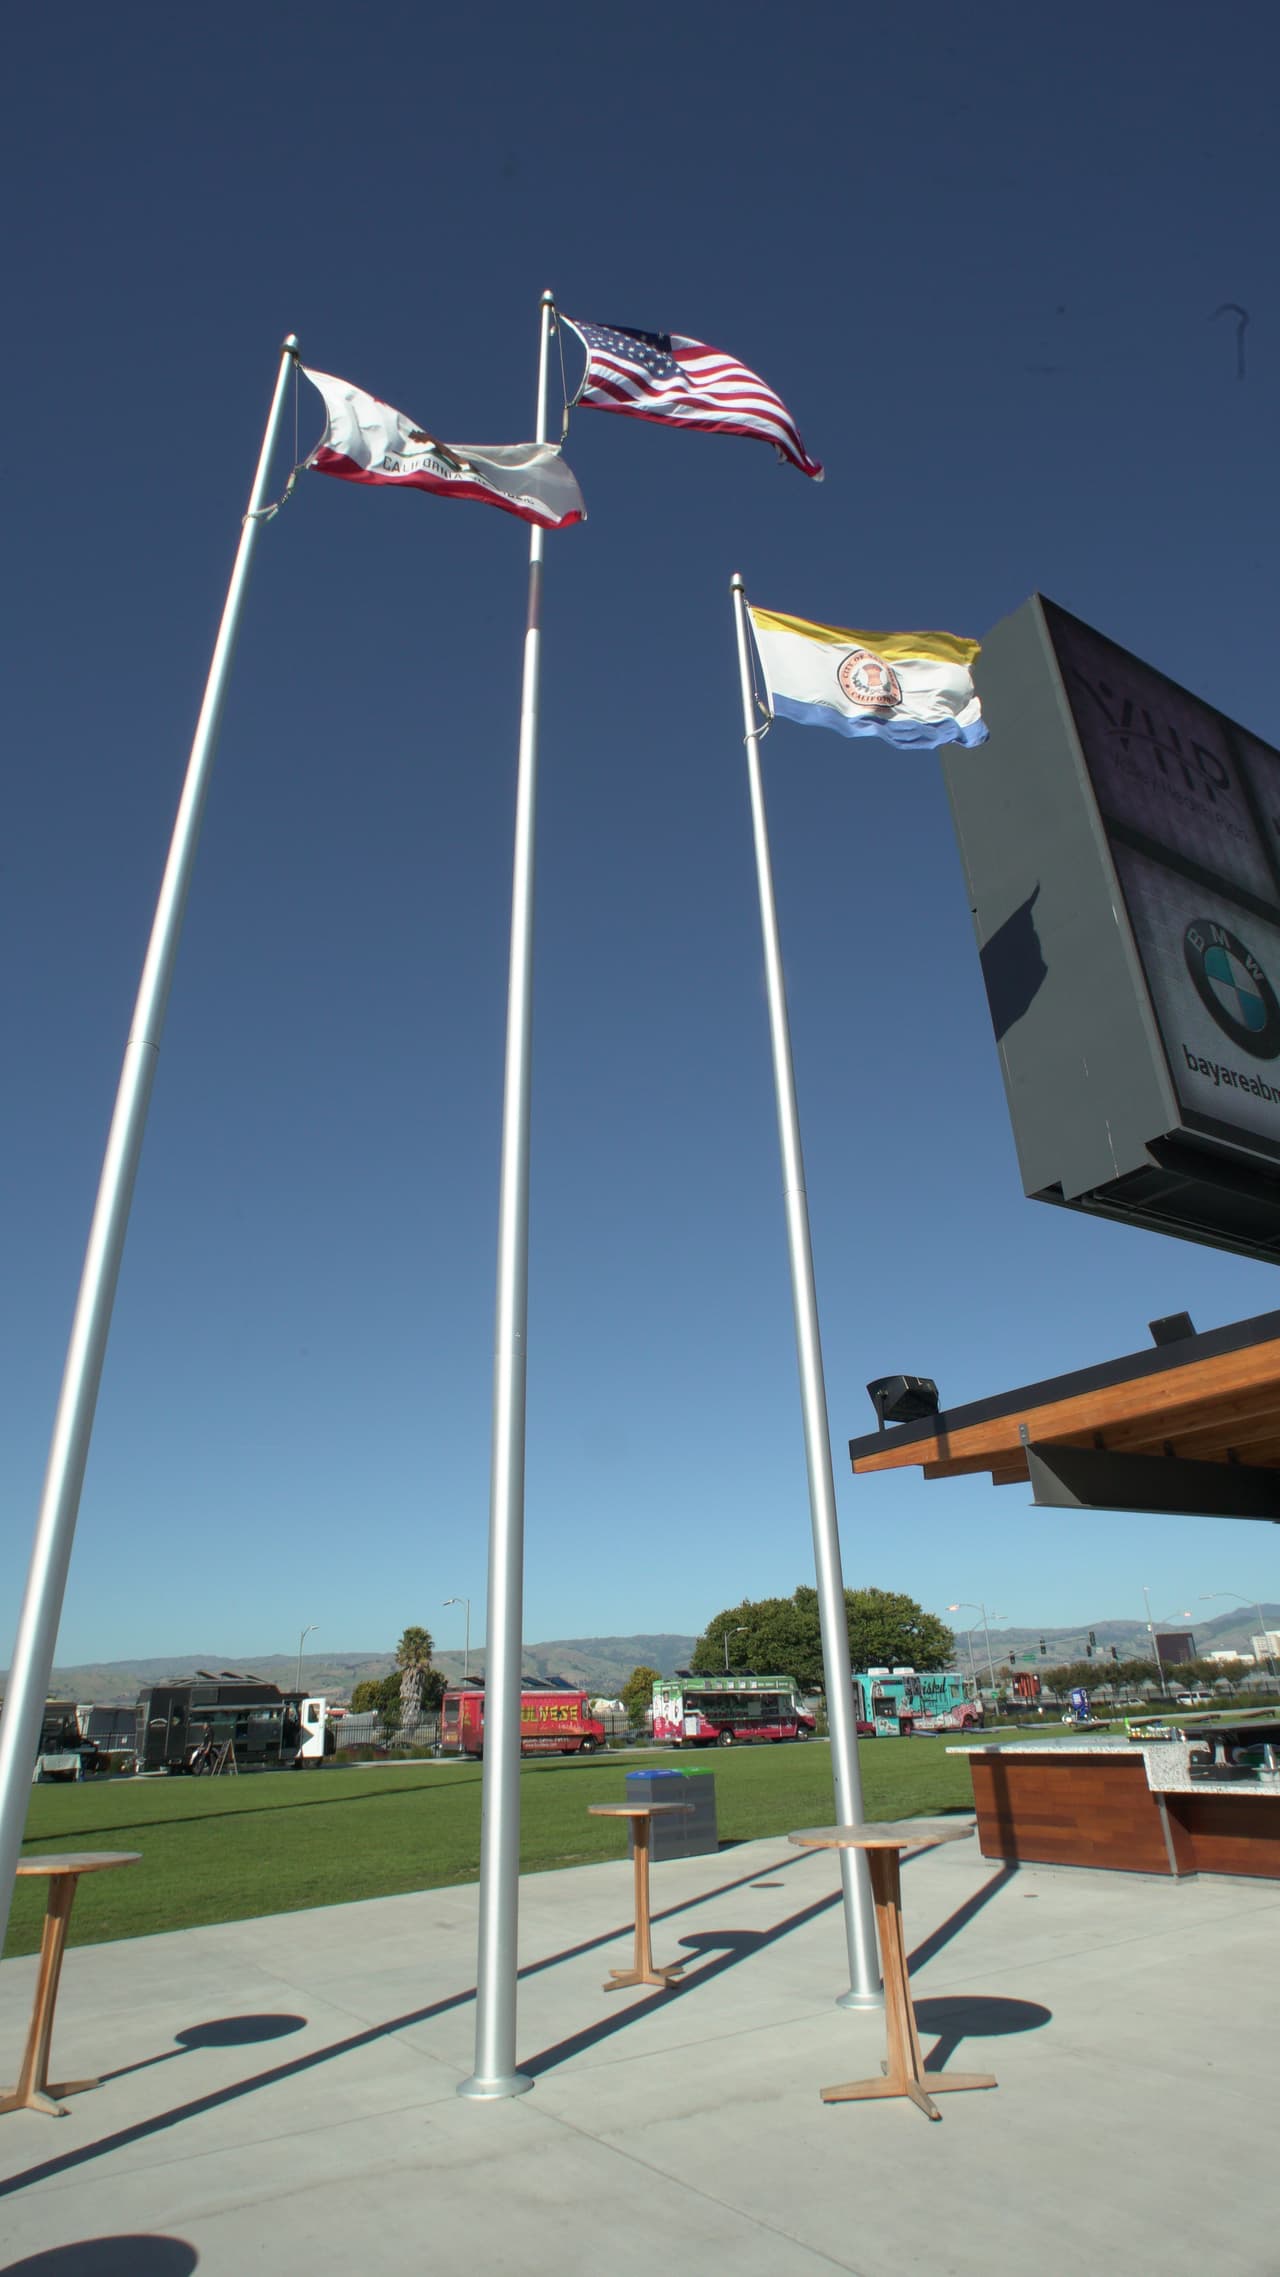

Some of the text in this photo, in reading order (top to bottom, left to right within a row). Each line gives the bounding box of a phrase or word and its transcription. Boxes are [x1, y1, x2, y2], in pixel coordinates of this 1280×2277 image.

[382, 455, 463, 481] CALIFORNIA
[1186, 923, 1265, 982] BMW
[520, 1704, 578, 1723] ULNESE
